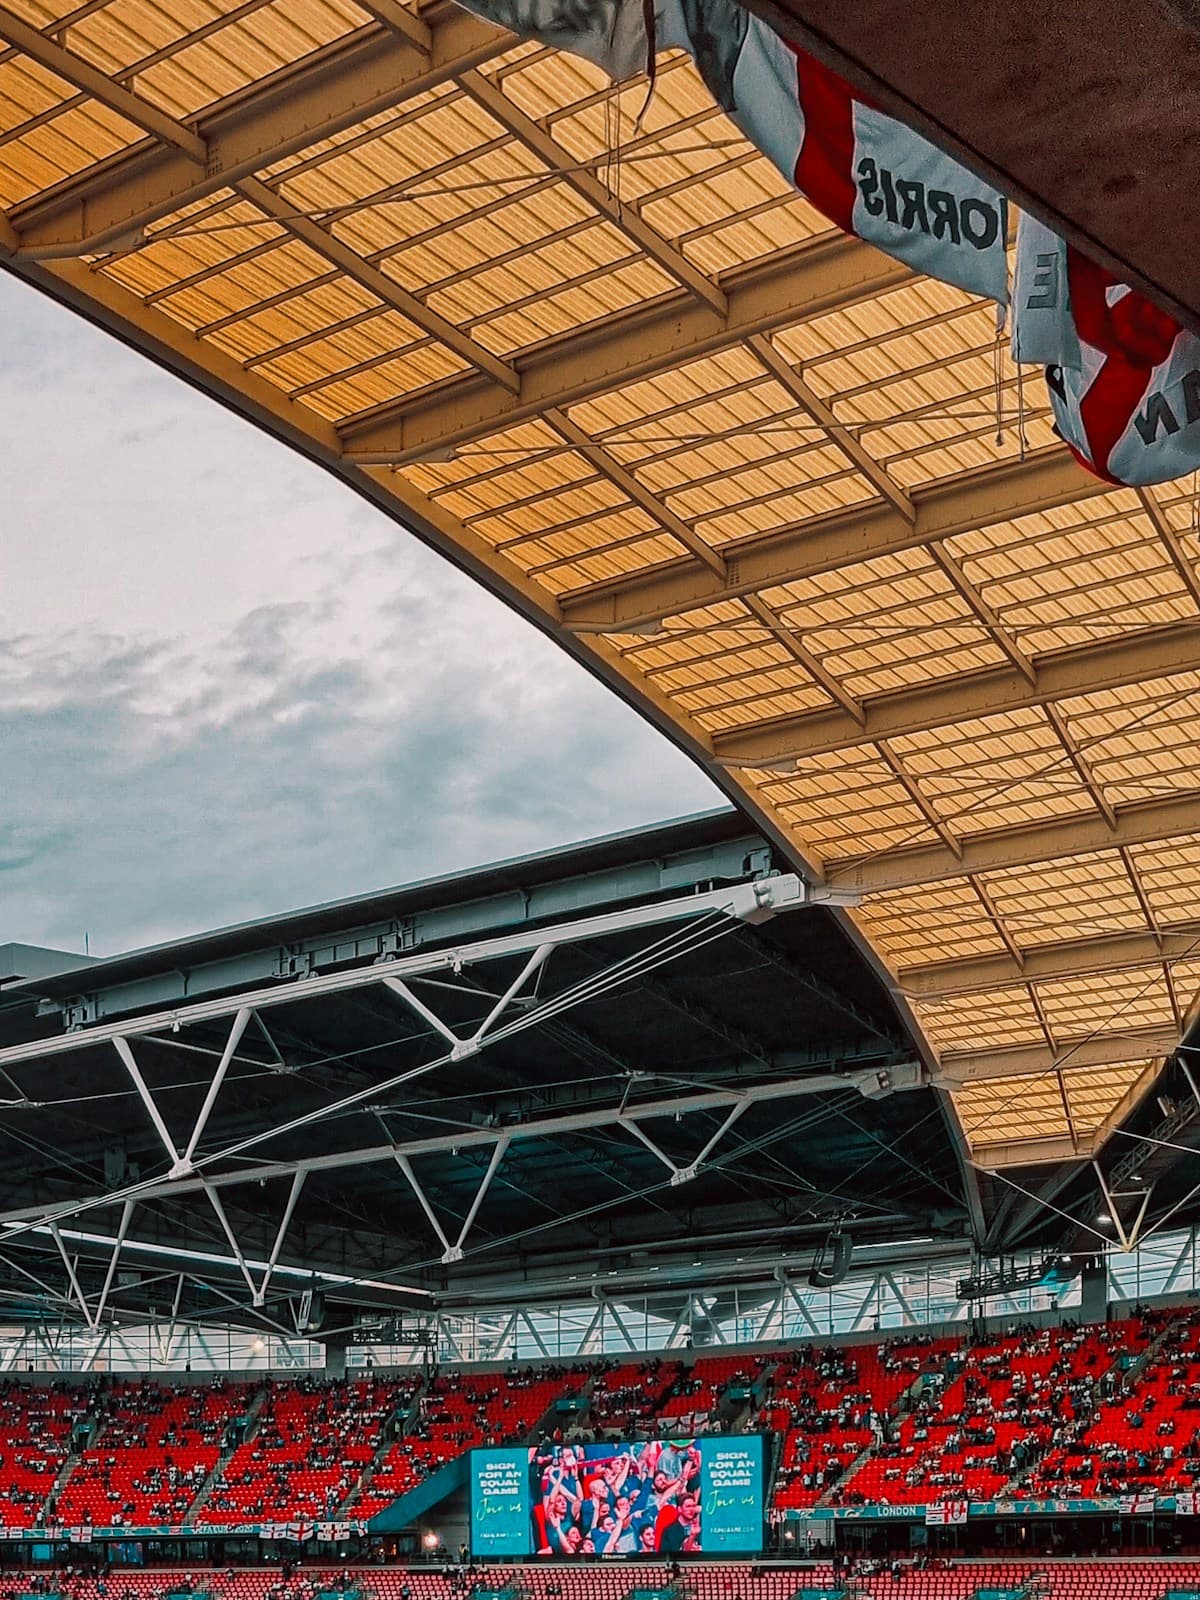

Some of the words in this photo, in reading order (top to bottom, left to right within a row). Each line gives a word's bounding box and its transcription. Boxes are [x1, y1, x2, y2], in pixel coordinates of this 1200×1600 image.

[716, 1452, 748, 1460] SIGN
[486, 1462, 515, 1471] SIGN
[708, 1461, 734, 1469] FOR
[736, 1460, 756, 1468] AN
[479, 1471, 502, 1479] FOR
[710, 1470, 752, 1479] EQUAL
[480, 1479, 520, 1488] EQUAL
[712, 1478, 751, 1487] GAME
[483, 1487, 519, 1495] GAME
[877, 1506, 917, 1517] LONDON
